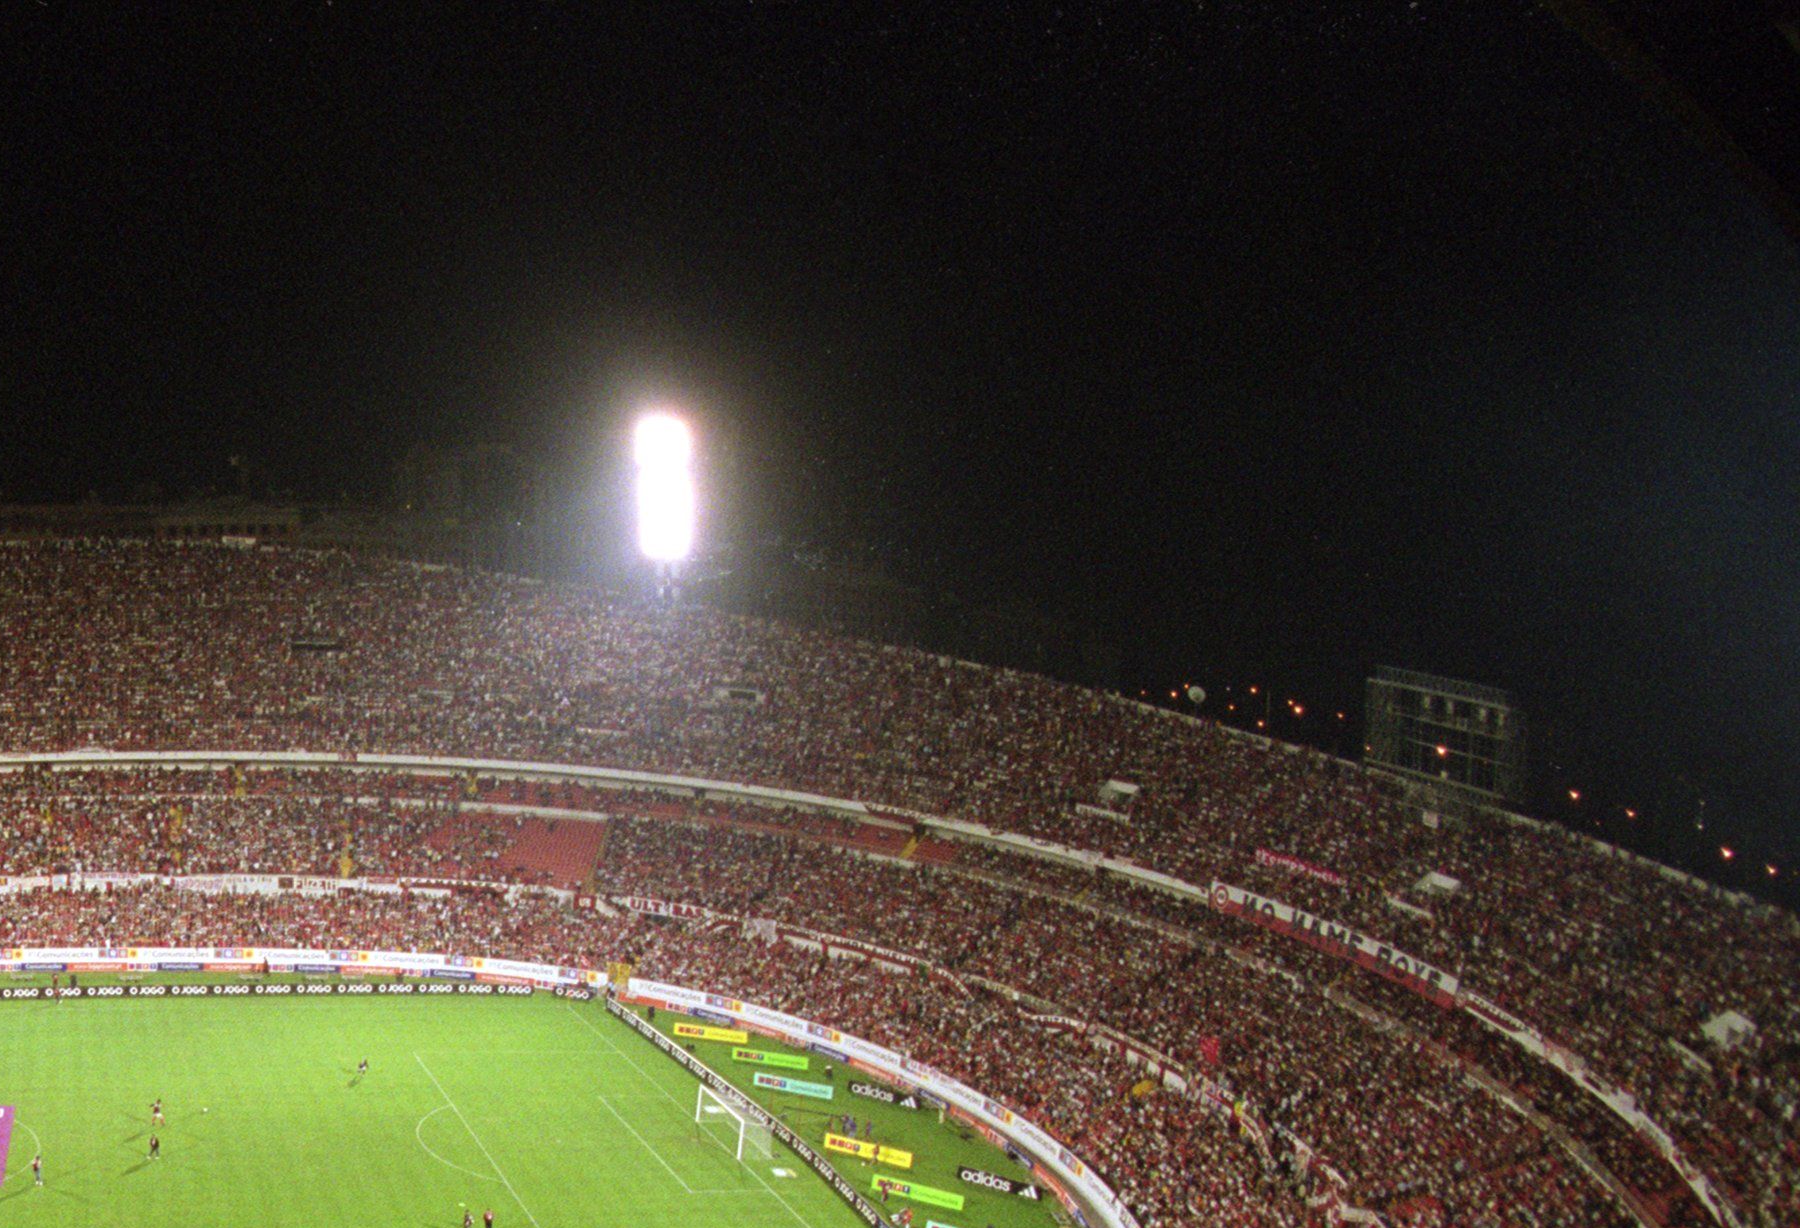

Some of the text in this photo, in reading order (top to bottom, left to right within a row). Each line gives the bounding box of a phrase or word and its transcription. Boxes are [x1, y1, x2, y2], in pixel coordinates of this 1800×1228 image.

[3, 987, 39, 998] O JOGO
[45, 986, 82, 997] O OGO
[87, 986, 124, 996] O JOGO
[129, 985, 166, 995] O JOGO
[171, 985, 208, 995] O JOGO
[213, 985, 250, 995] O JOGO
[255, 984, 291, 994] O JOGO
[296, 984, 332, 993] O JOGO
[338, 984, 373, 993] O JOGO
[378, 984, 413, 993] O JOGO
[419, 984, 453, 993] O JOGO
[458, 984, 493, 994] O JOGO
[498, 984, 532, 994] O JOGO
[556, 986, 589, 1000] O JOGO
[851, 1082, 894, 1103] adidas
[960, 1167, 1012, 1193] adidas
